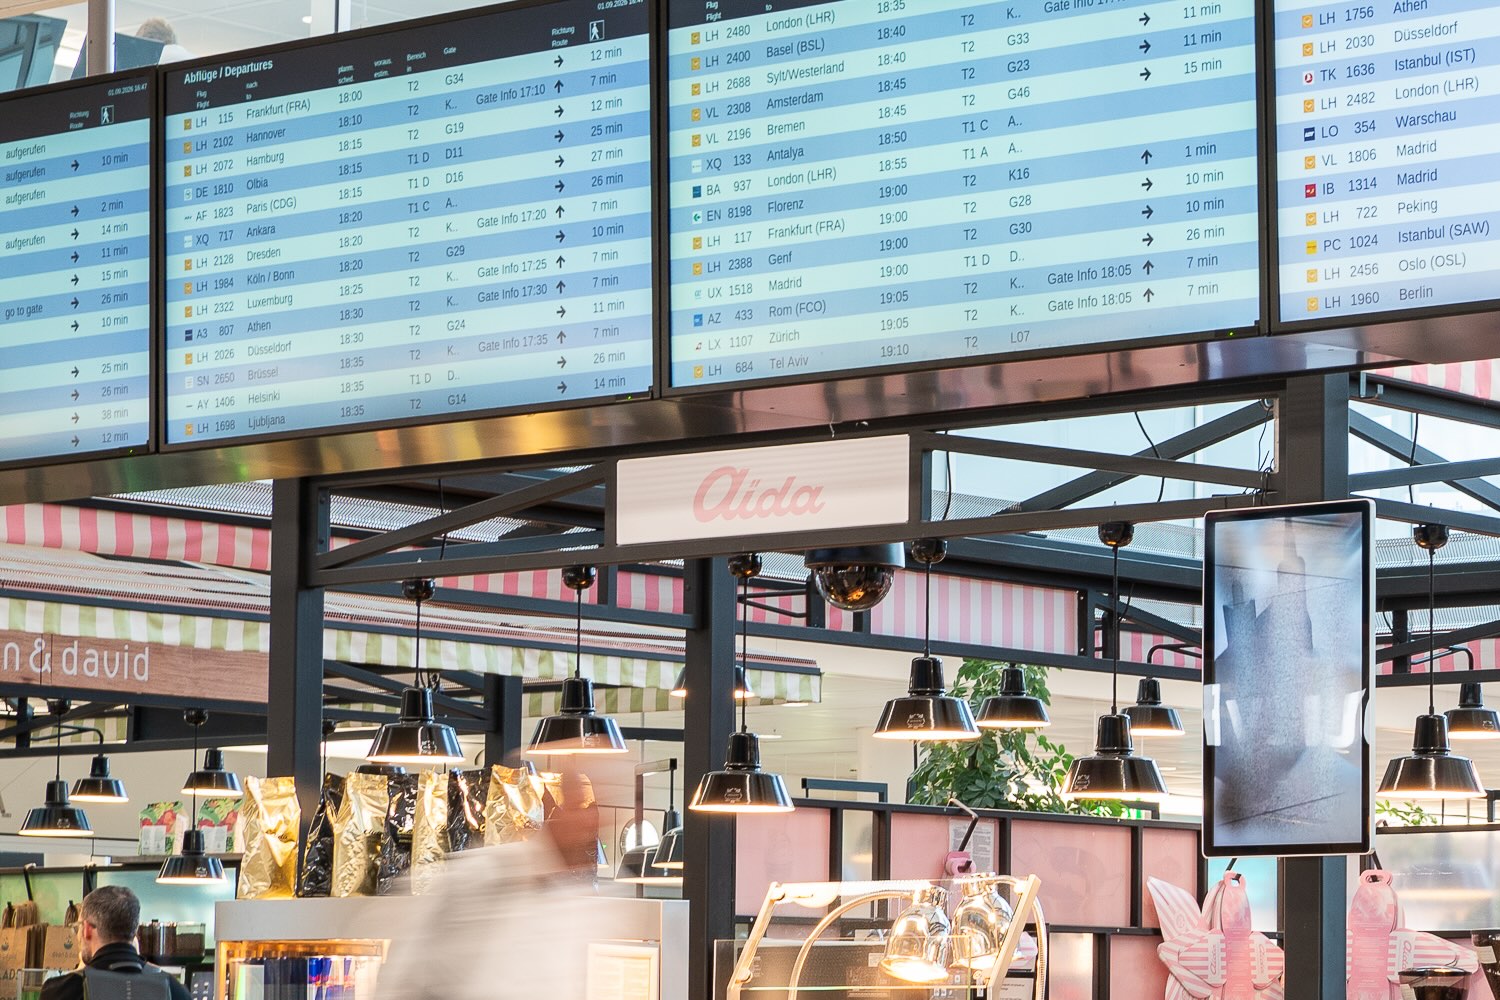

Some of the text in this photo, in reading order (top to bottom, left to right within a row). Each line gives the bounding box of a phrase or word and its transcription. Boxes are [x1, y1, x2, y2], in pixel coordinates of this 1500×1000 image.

[184, 68, 218, 84] Abflüge
[224, 59, 273, 78] Departures
[705, 32, 1221, 118] VL 2308 Amsterdam 18:45 T2 G23 11 min
[1320, 68, 1336, 81] TK
[1347, 63, 1375, 78] 1636
[1395, 52, 1441, 71] Istanbul
[1446, 48, 1475, 67] (IST)
[196, 140, 207, 152] LH
[213, 135, 233, 149] 2102
[246, 128, 286, 143] Hannover
[339, 114, 362, 128] 18:10
[408, 104, 419, 116] T2
[476, 93, 498, 105] Gate
[500, 88, 518, 101] Info
[520, 84, 545, 98] 17:10
[591, 75, 596, 86] 7
[599, 74, 616, 85] min
[1321, 125, 1338, 138] LO
[1355, 120, 1376, 134] 354
[1395, 110, 1456, 128] Warschau
[5, 154, 128, 183] aufgerufen 10 min
[196, 123, 623, 198] DE 1810 Olbia 18:15 T1 D D11 25 min
[707, 144, 1216, 222] EN 8198 Florenz 19:00 T2 K16 1 min
[5, 293, 128, 319] go to gate 26 min
[708, 312, 721, 324] AZ
[735, 309, 753, 320] 433
[769, 306, 792, 317] Rom
[795, 299, 826, 317] (FCO)
[881, 290, 909, 304] 19:05
[964, 282, 977, 294] T2
[1048, 272, 1073, 285] Gate
[1077, 268, 1098, 281] Info
[1101, 264, 1131, 279] 18:05
[1187, 256, 1193, 268] 7
[1197, 256, 1218, 267] min
[1325, 296, 1341, 309] LH
[1351, 291, 1379, 306] 1960
[1400, 286, 1433, 300] Berlin
[197, 377, 626, 434] LH 1698 Ljubljana 18:35 T2 G14 14 min
[61, 640, 149, 682] david
